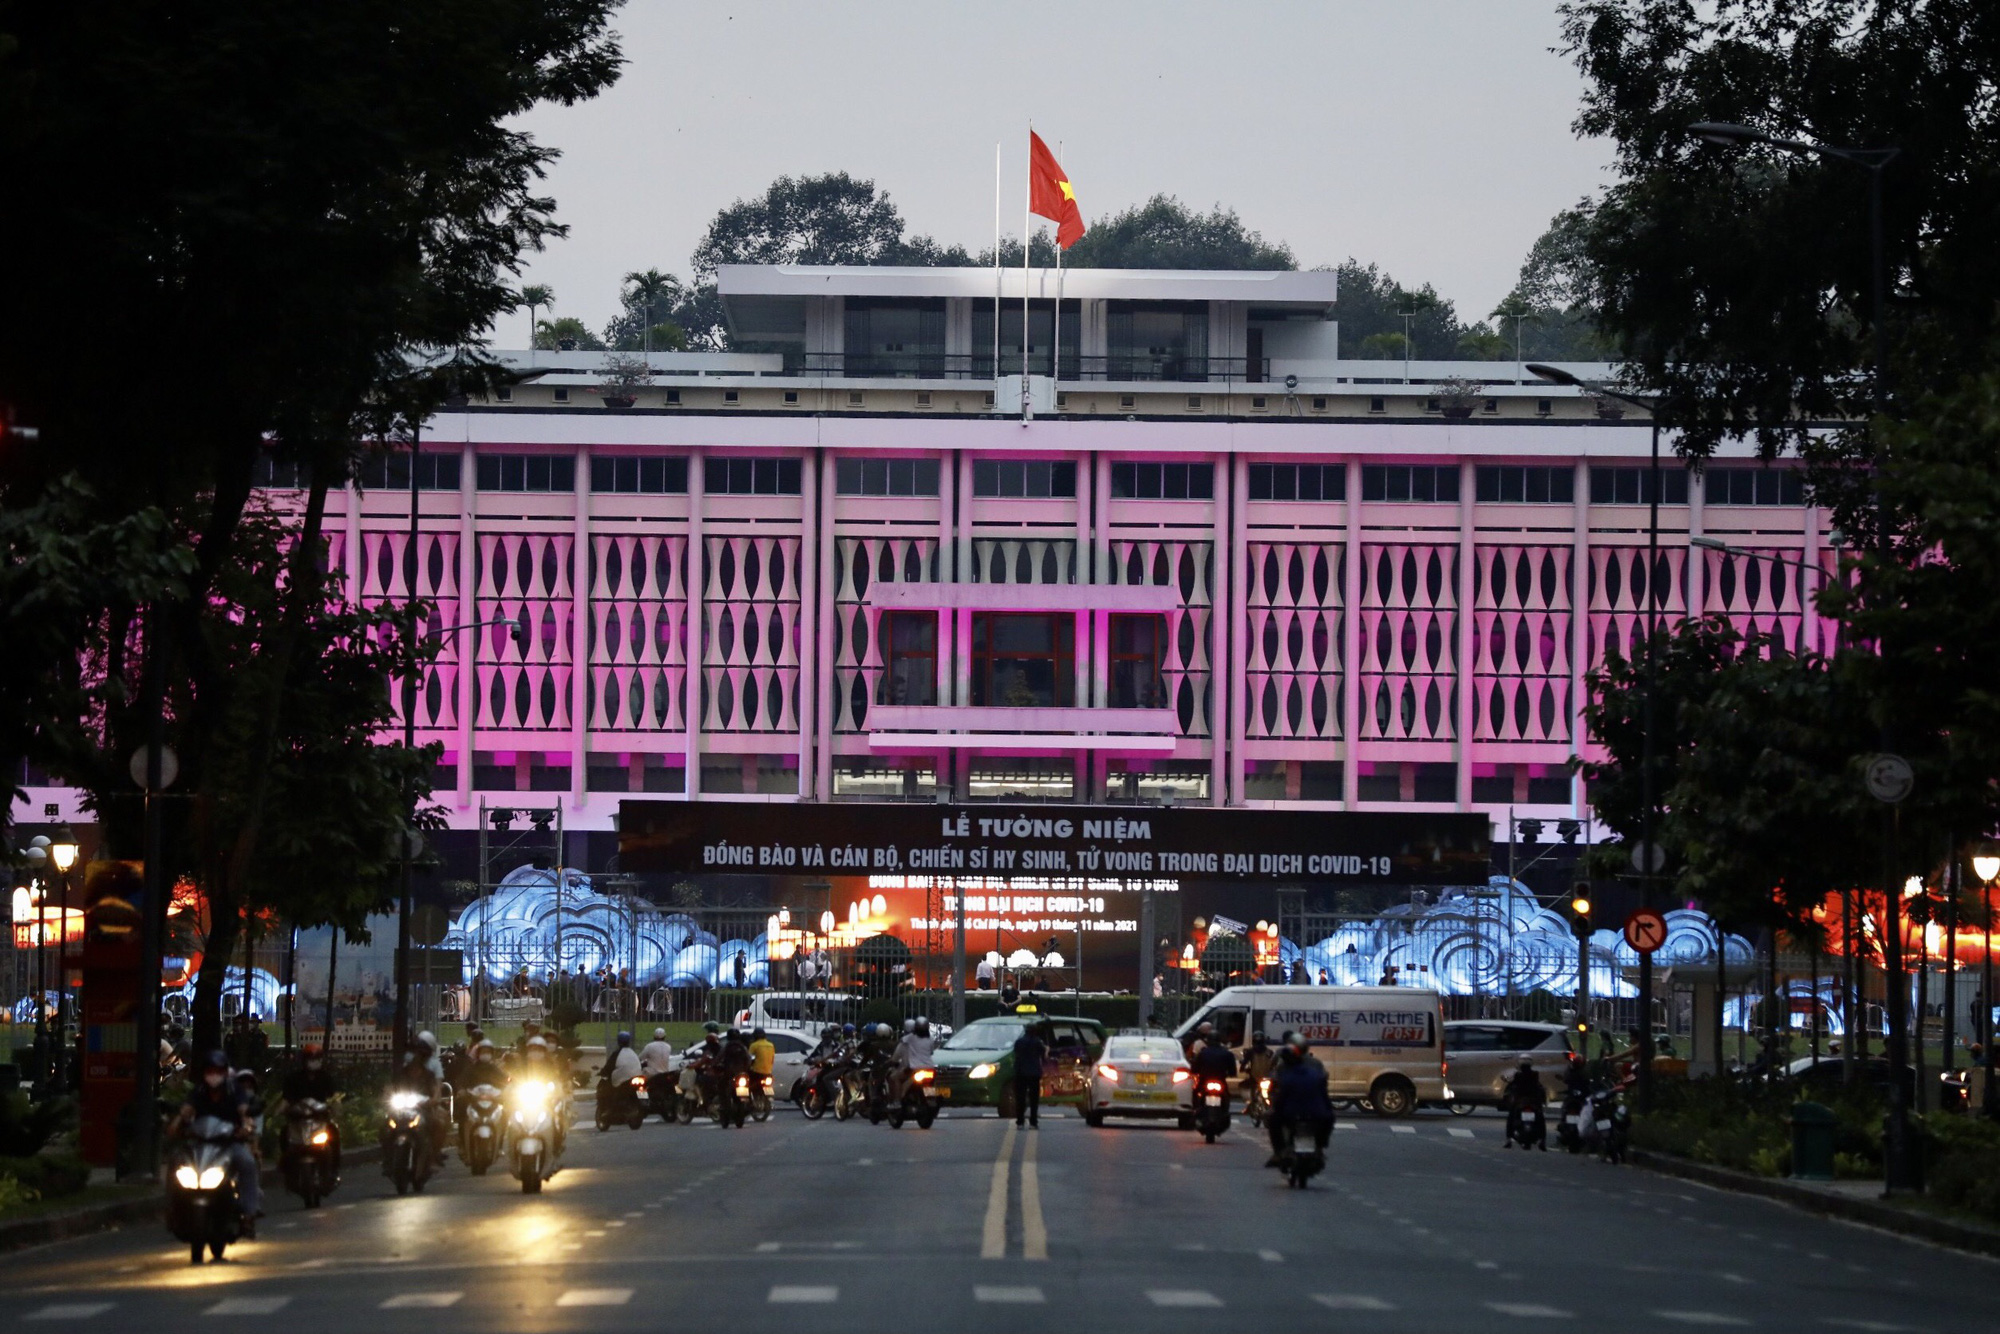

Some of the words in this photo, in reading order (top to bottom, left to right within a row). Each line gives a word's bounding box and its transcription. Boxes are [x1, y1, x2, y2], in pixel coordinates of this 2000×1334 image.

[943, 811, 970, 837] LỄ
[978, 814, 1074, 838] TƯỞNG
[1083, 817, 1152, 843] NIỆM
[703, 839, 753, 865] ĐỒNG
[759, 842, 796, 866] BÀO
[801, 843, 825, 866] VÀ
[830, 844, 868, 867] CÁN
[873, 844, 903, 871] BỘ,
[909, 843, 964, 868] CHIẾN
[969, 845, 988, 868] SĨ
[993, 849, 1017, 869] HY
[1021, 850, 1071, 872] SINH,
[1076, 845, 1101, 870] TỬ
[1104, 851, 1153, 871] VONG
[1157, 852, 1218, 873] TRONG
[1222, 853, 1254, 876] ĐẠI
[1259, 854, 1303, 877] DỊCH
[1308, 855, 1391, 876] COVID-19
[1383, 1027, 1424, 1040] POST
